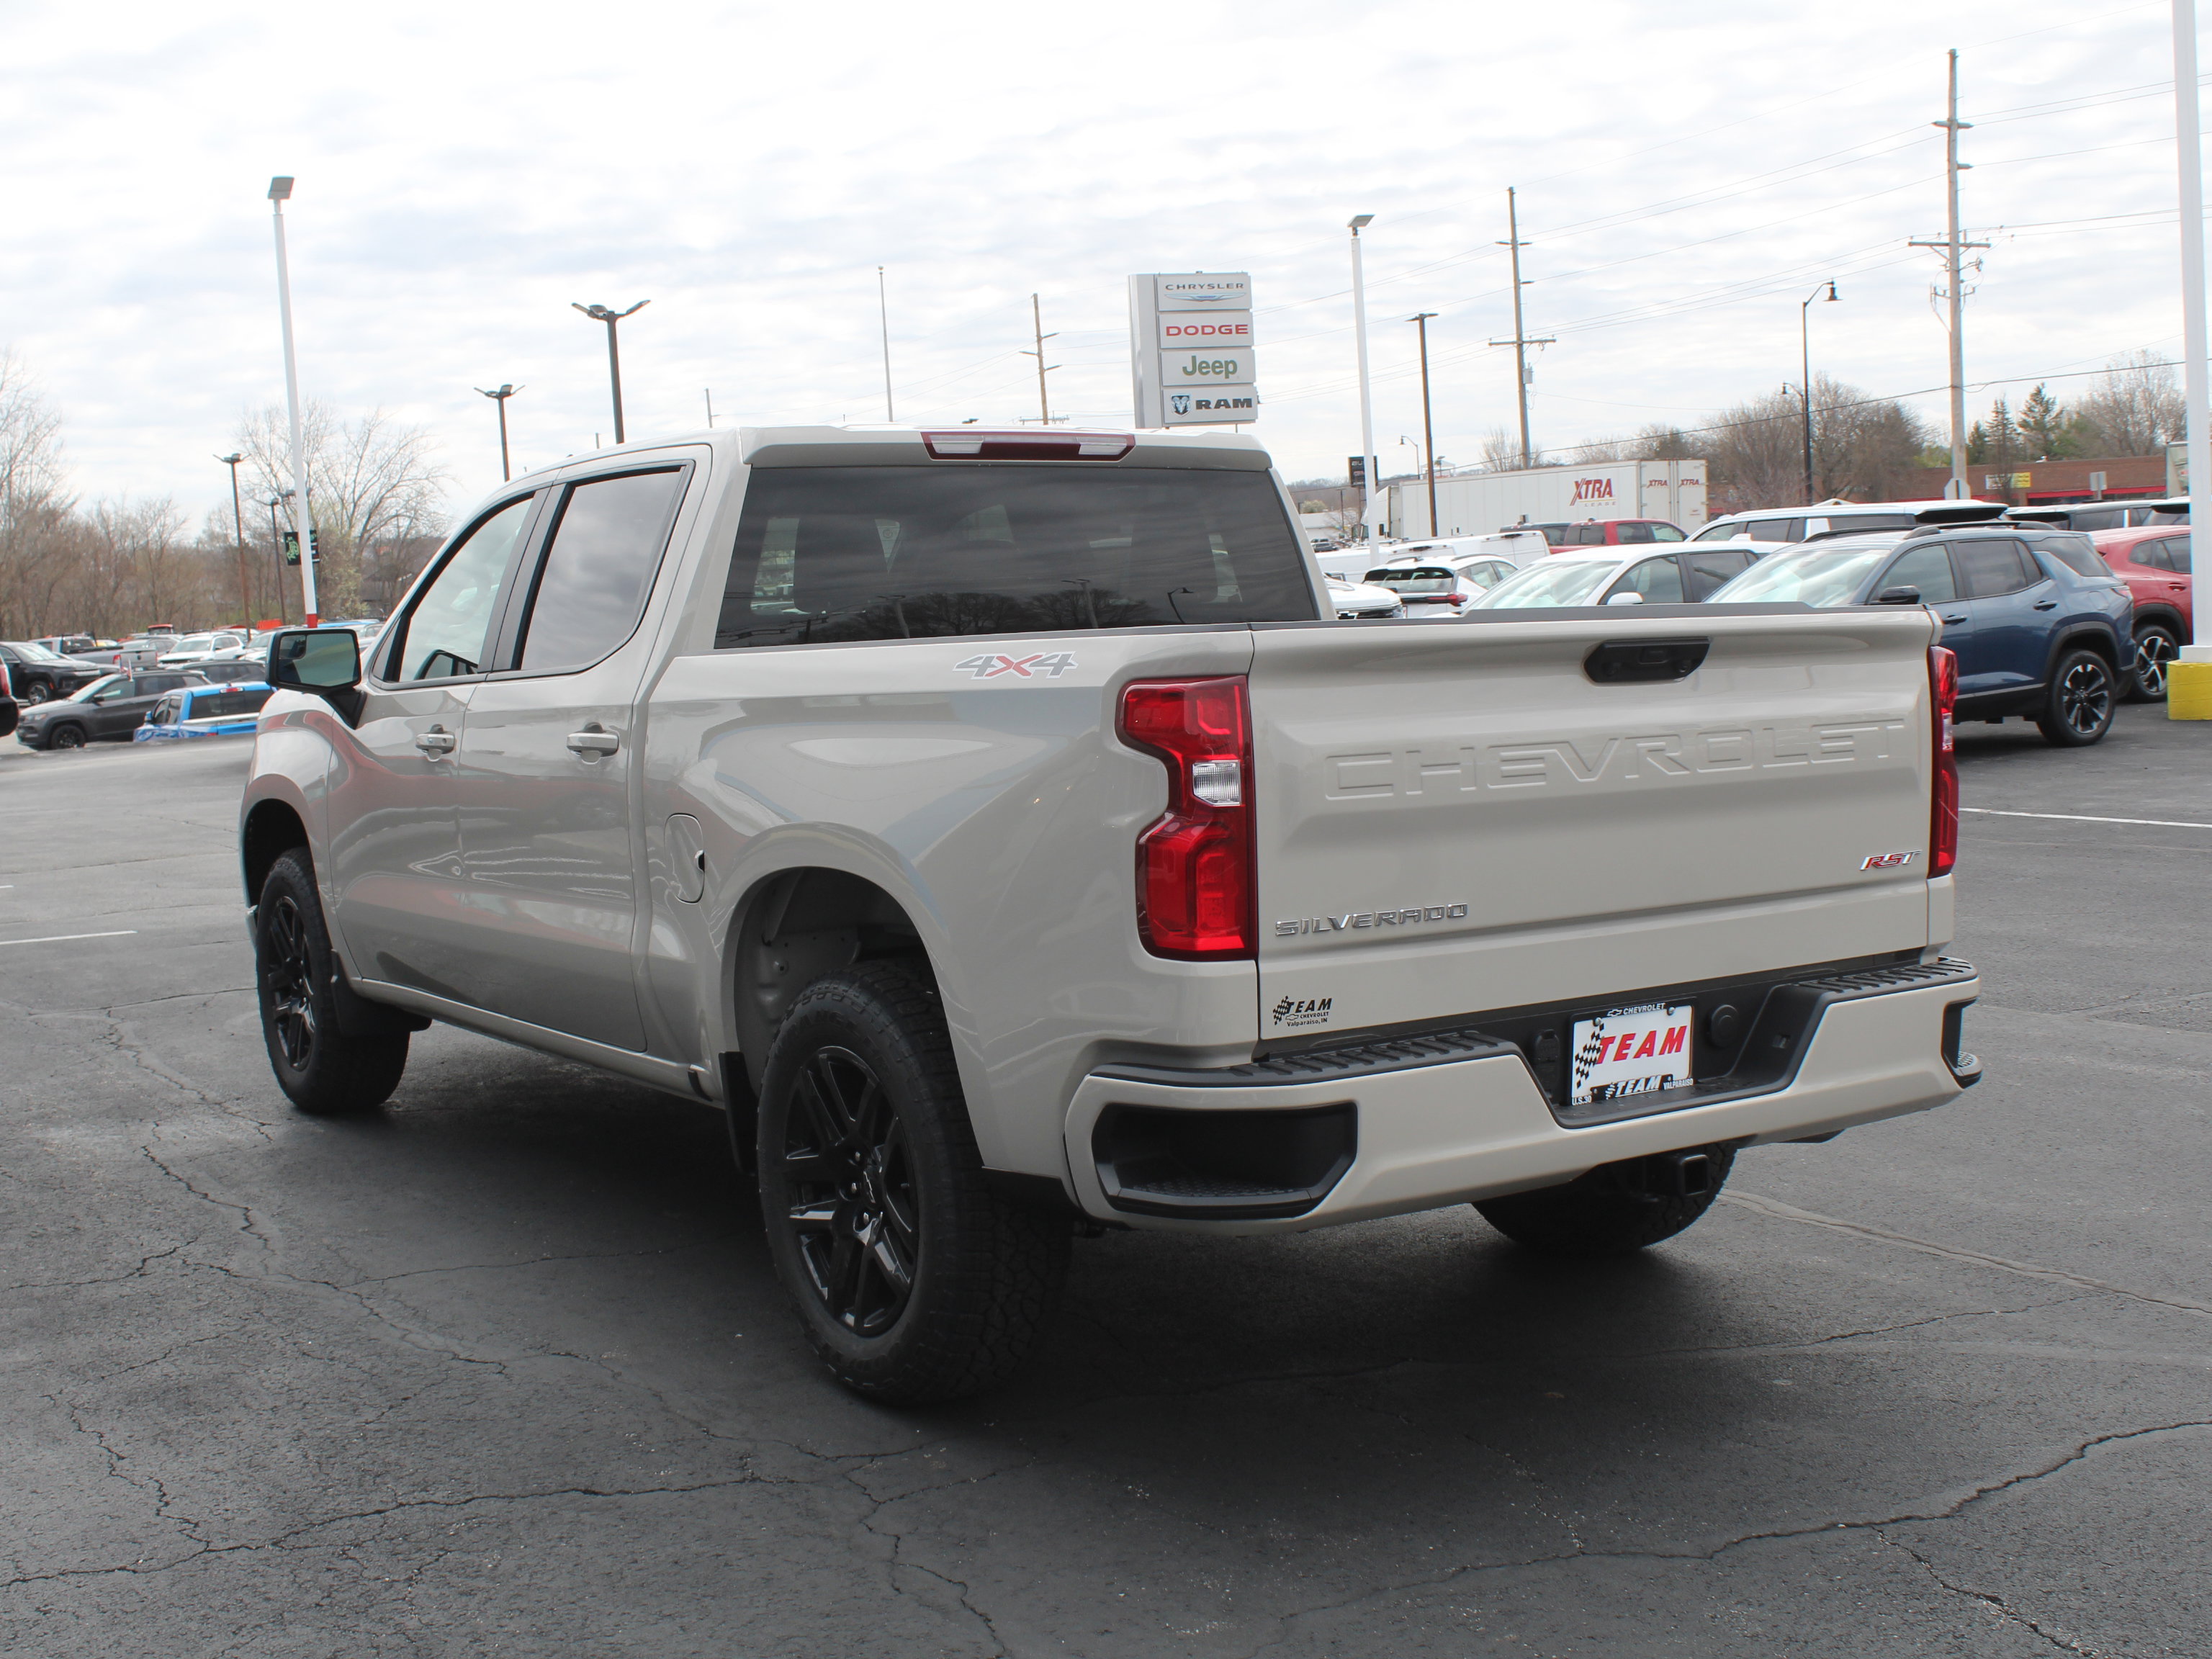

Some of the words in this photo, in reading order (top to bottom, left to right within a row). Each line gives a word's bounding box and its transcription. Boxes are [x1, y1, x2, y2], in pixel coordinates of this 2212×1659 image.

[1166, 324, 1249, 336] DODGE
[1182, 355, 1238, 379] Jeep
[1195, 397, 1253, 410] RAM
[1570, 477, 1614, 506] XTRA
[1647, 479, 1668, 488] XTRA
[1678, 479, 1700, 488] XTRA
[1325, 719, 1905, 801] CHEVROLET
[1859, 850, 1923, 871] RST
[1275, 902, 1468, 936] SILVERADO
[1286, 998, 1332, 1014] TEAM
[1623, 1002, 1666, 1015] CHEVROLET
[1595, 1025, 1687, 1064] TEAM
[1615, 1075, 1663, 1096] TEAM
[1663, 1079, 1694, 1090] VALPARAISO
